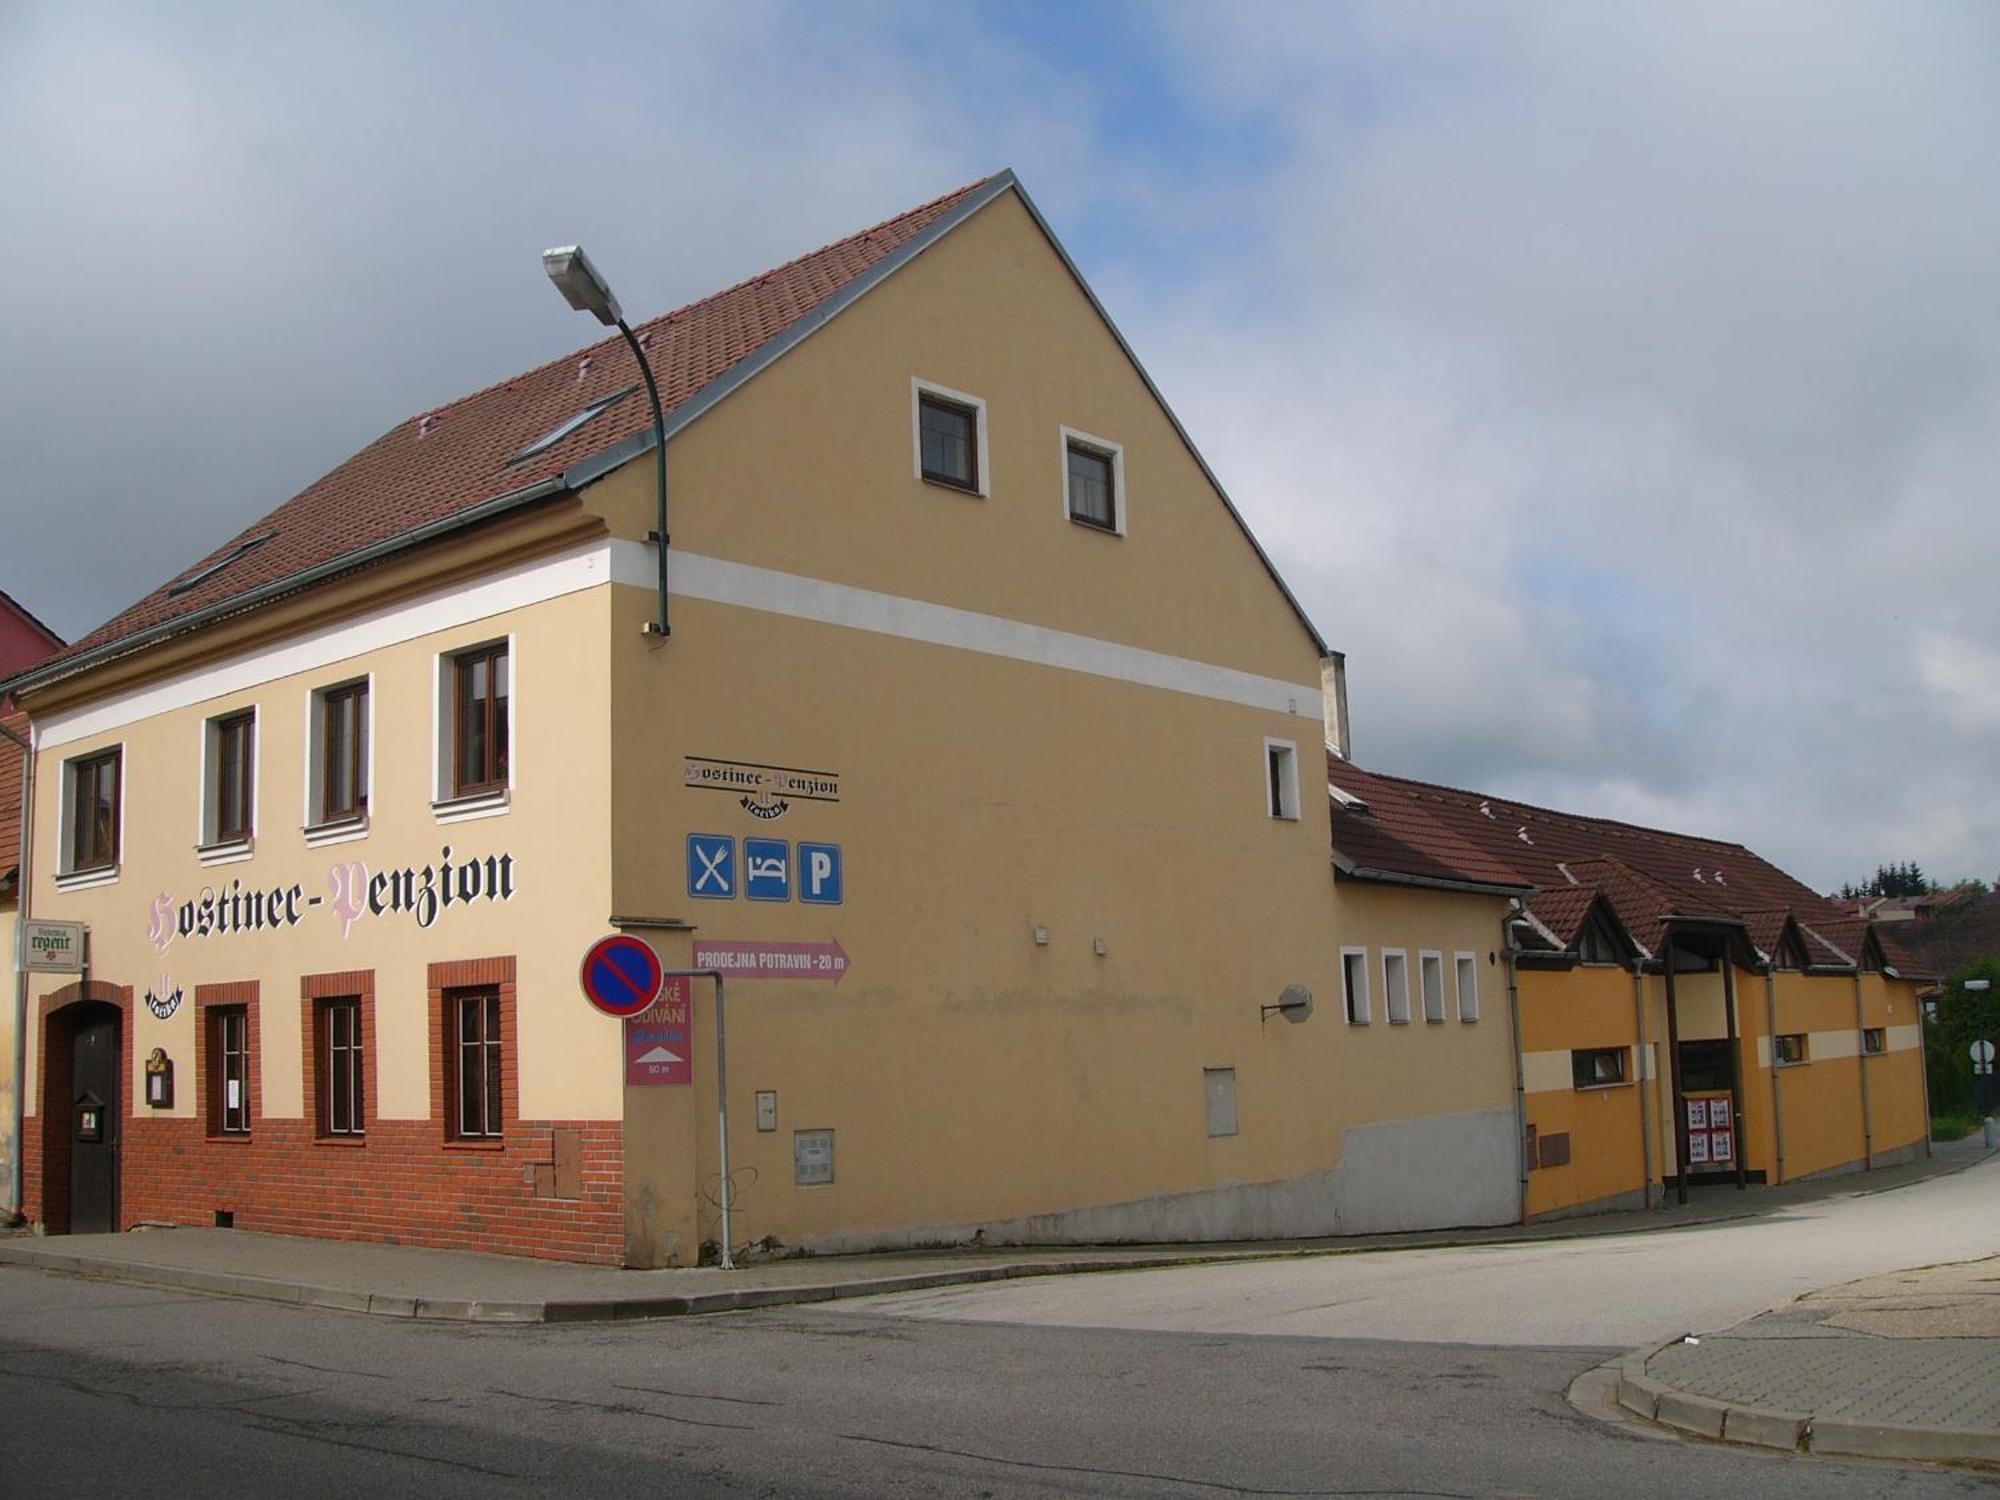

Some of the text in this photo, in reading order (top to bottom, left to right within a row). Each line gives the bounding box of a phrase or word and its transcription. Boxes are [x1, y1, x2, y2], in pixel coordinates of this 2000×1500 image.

[811, 851, 832, 895] P
[697, 952, 757, 968] PRODEJNA
[760, 952, 811, 969] POTRAVIN
[819, 955, 832, 969] 20
[834, 957, 844, 970] m
[657, 982, 681, 1002] SKÉ
